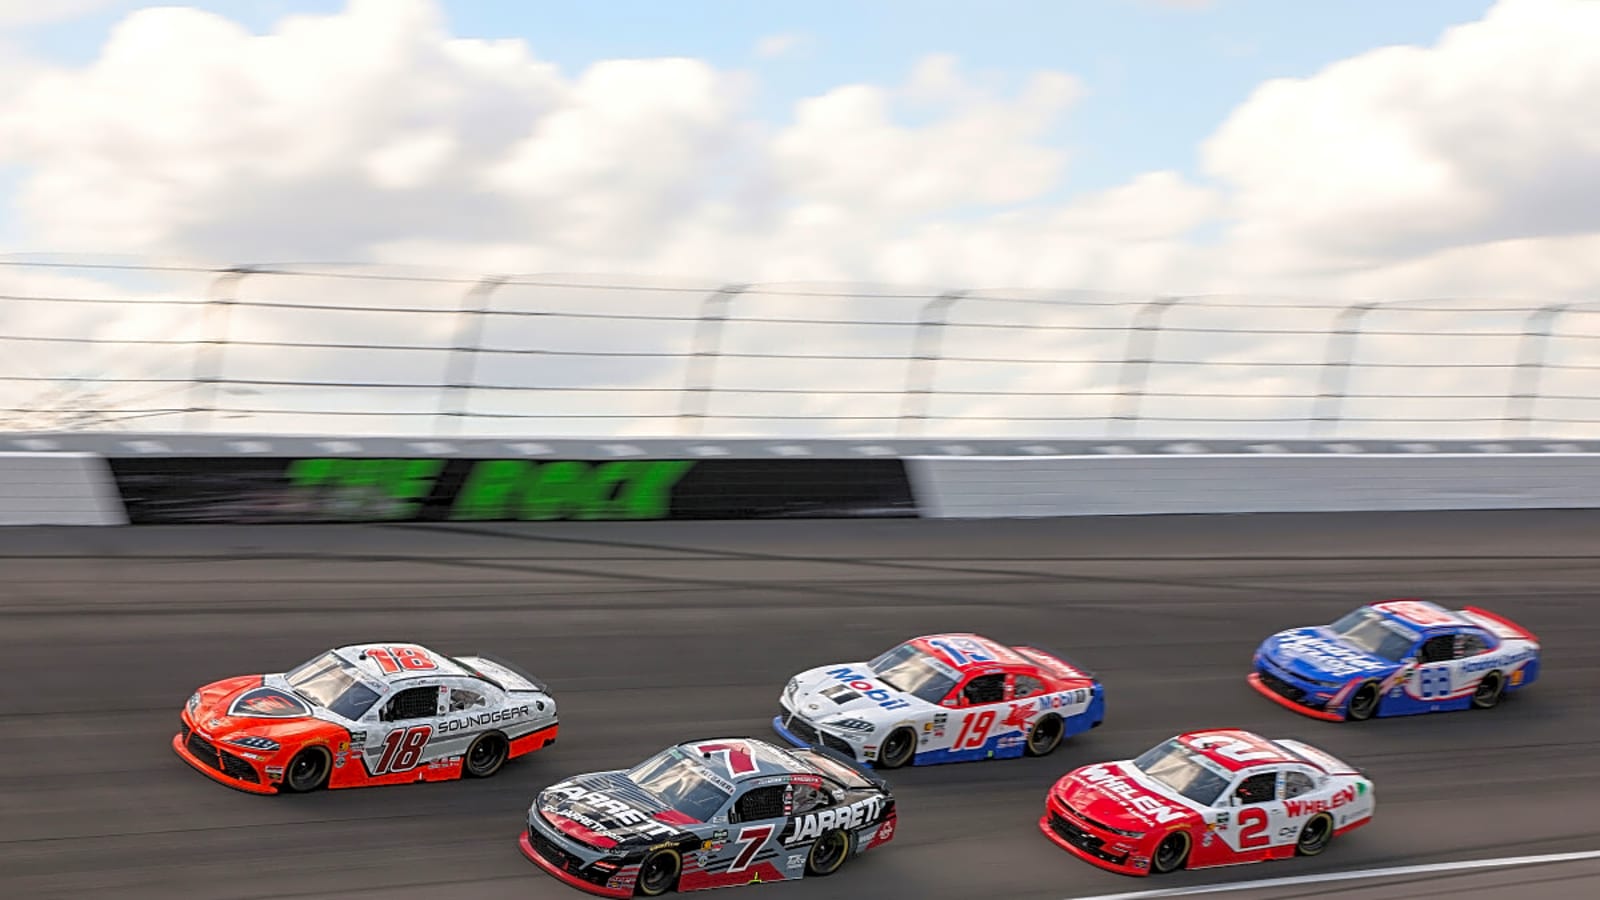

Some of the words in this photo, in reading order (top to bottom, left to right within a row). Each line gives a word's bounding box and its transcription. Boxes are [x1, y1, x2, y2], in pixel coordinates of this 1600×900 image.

[364, 646, 438, 674] 18
[929, 637, 998, 666] 19
[827, 666, 910, 710] Mobil
[1039, 691, 1073, 710] Mobil
[438, 705, 530, 733] SOUNDGEAR
[951, 710, 997, 752] 19
[373, 725, 433, 775] 18
[695, 739, 761, 778] 7
[1189, 735, 1281, 761] 2
[545, 781, 681, 837] JARRETT
[1080, 765, 1189, 824] WHELEN
[1283, 785, 1355, 818] WHELEN
[785, 794, 885, 844] JARRETT
[1237, 807, 1270, 849] 2
[726, 818, 775, 873] 7
